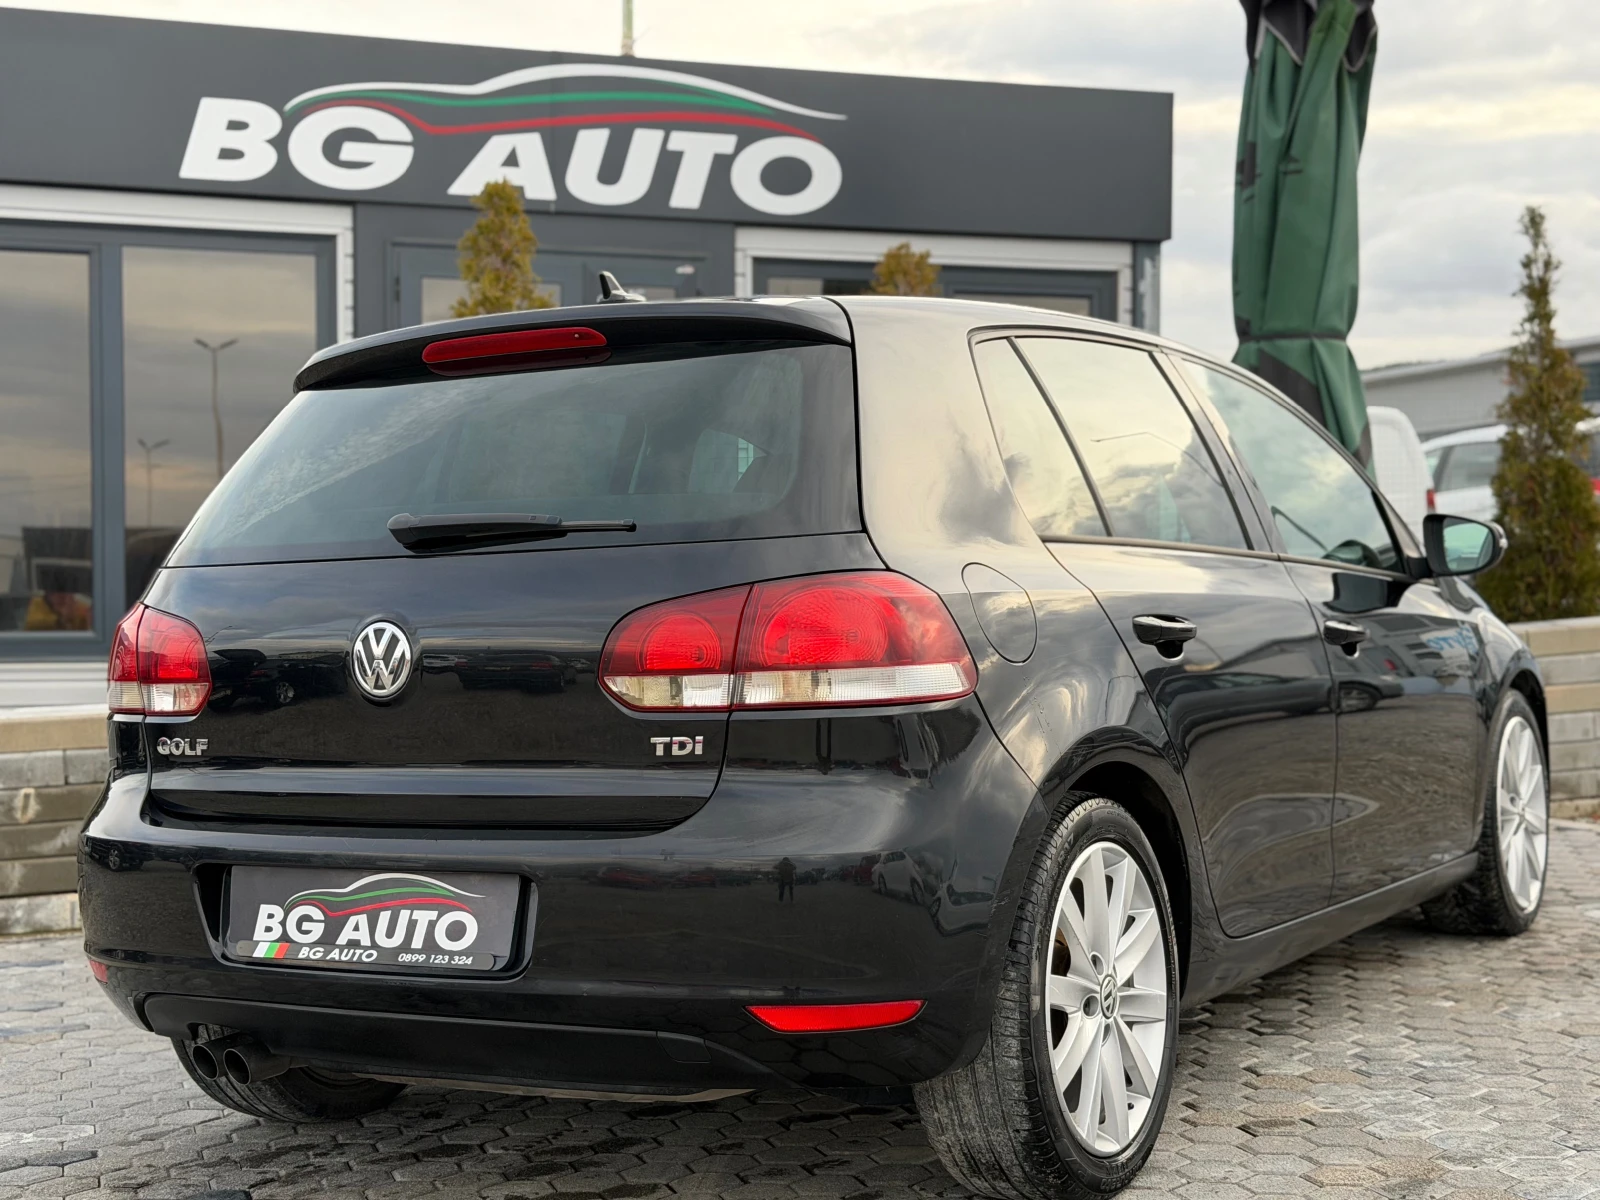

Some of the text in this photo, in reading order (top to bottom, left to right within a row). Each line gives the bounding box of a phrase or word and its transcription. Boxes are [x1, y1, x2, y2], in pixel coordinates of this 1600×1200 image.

[179, 97, 842, 215] BG AUTO
[156, 737, 208, 755] GOLF
[650, 736, 704, 756] TDI
[253, 904, 478, 951] BG AUTO
[297, 946, 474, 966] BG AUTO 0899 123 324
